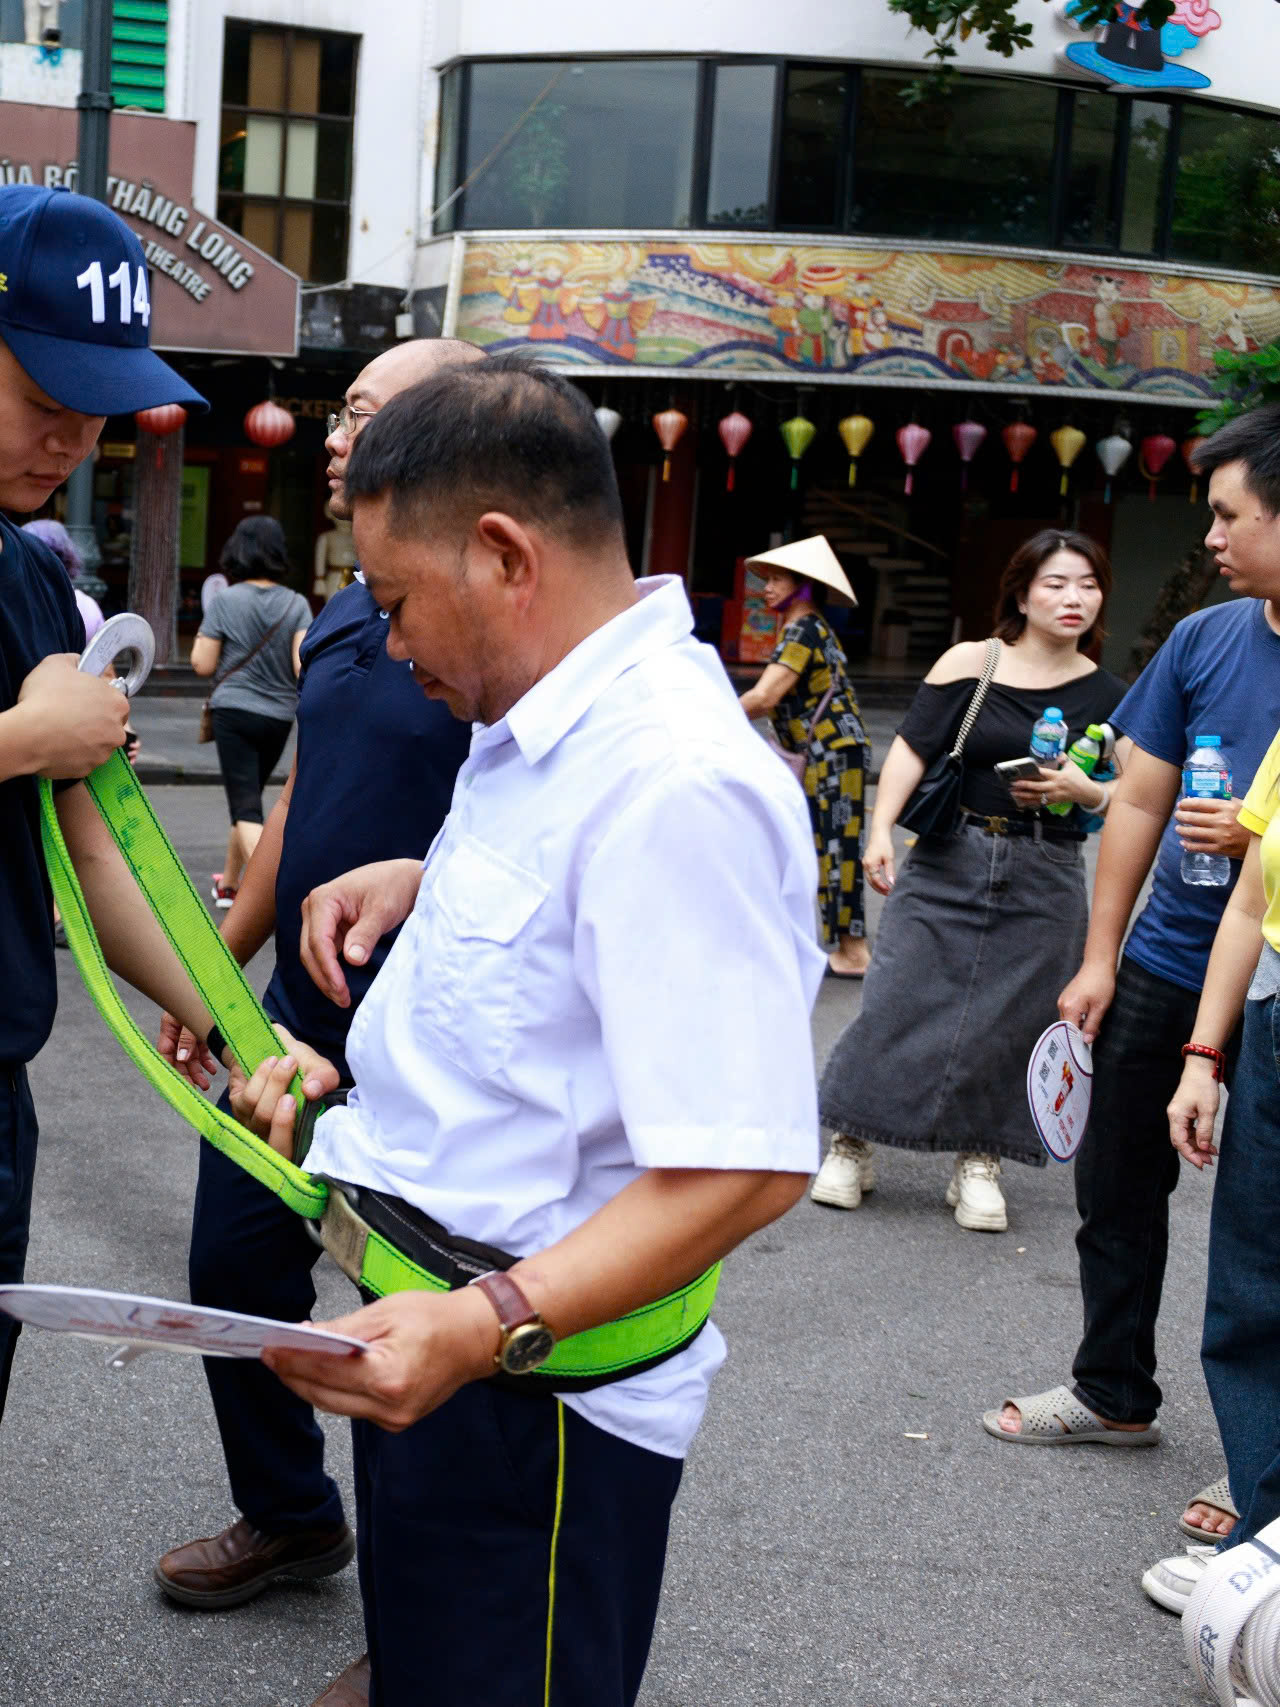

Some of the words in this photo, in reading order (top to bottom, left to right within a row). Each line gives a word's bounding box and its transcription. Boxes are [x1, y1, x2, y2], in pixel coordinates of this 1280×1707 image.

[144, 240, 213, 302] THEATRE
[185, 221, 255, 291] LONG
[76, 261, 151, 328] 114
